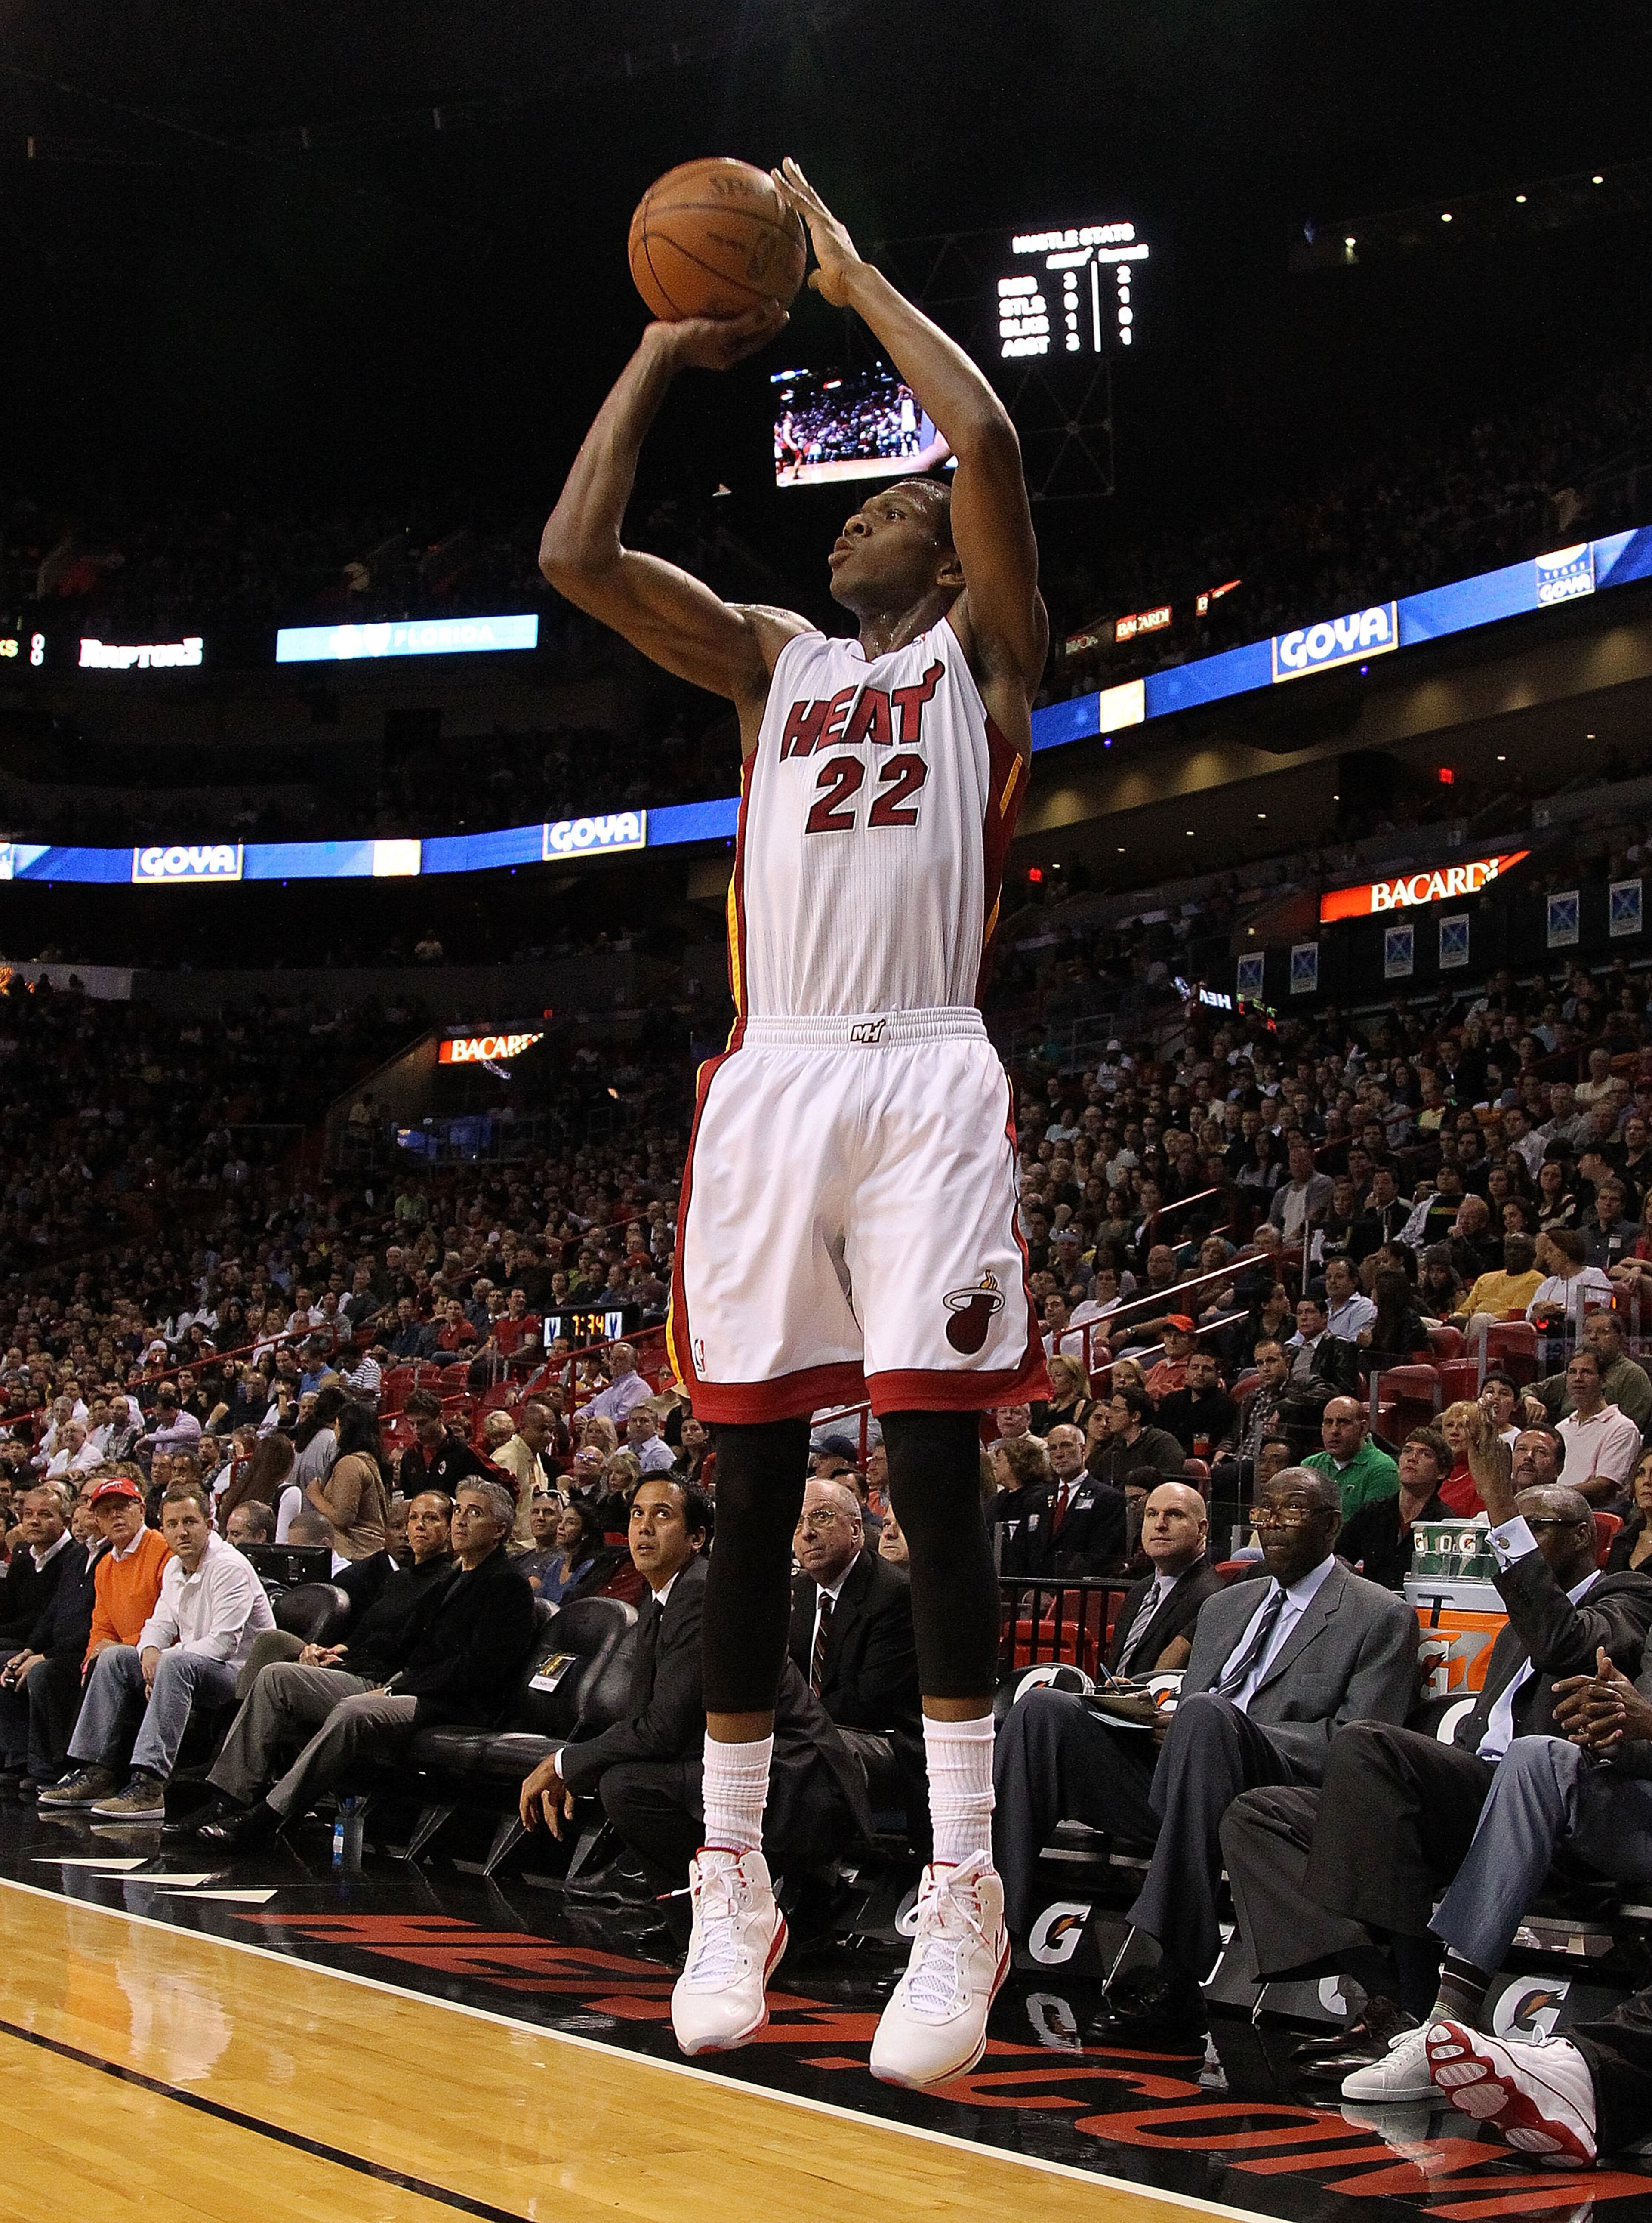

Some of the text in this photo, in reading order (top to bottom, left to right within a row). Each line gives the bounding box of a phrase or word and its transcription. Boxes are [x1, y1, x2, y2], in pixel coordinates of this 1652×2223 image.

[1079, 223, 1135, 245] STATS
[1539, 573, 1591, 601] GOYA
[394, 624, 495, 647] FLORIDA
[1280, 607, 1388, 668] GOYA
[779, 659, 945, 764] HEAT
[804, 753, 930, 837] 22
[550, 812, 638, 851] GOYA
[140, 845, 236, 877] GOYA
